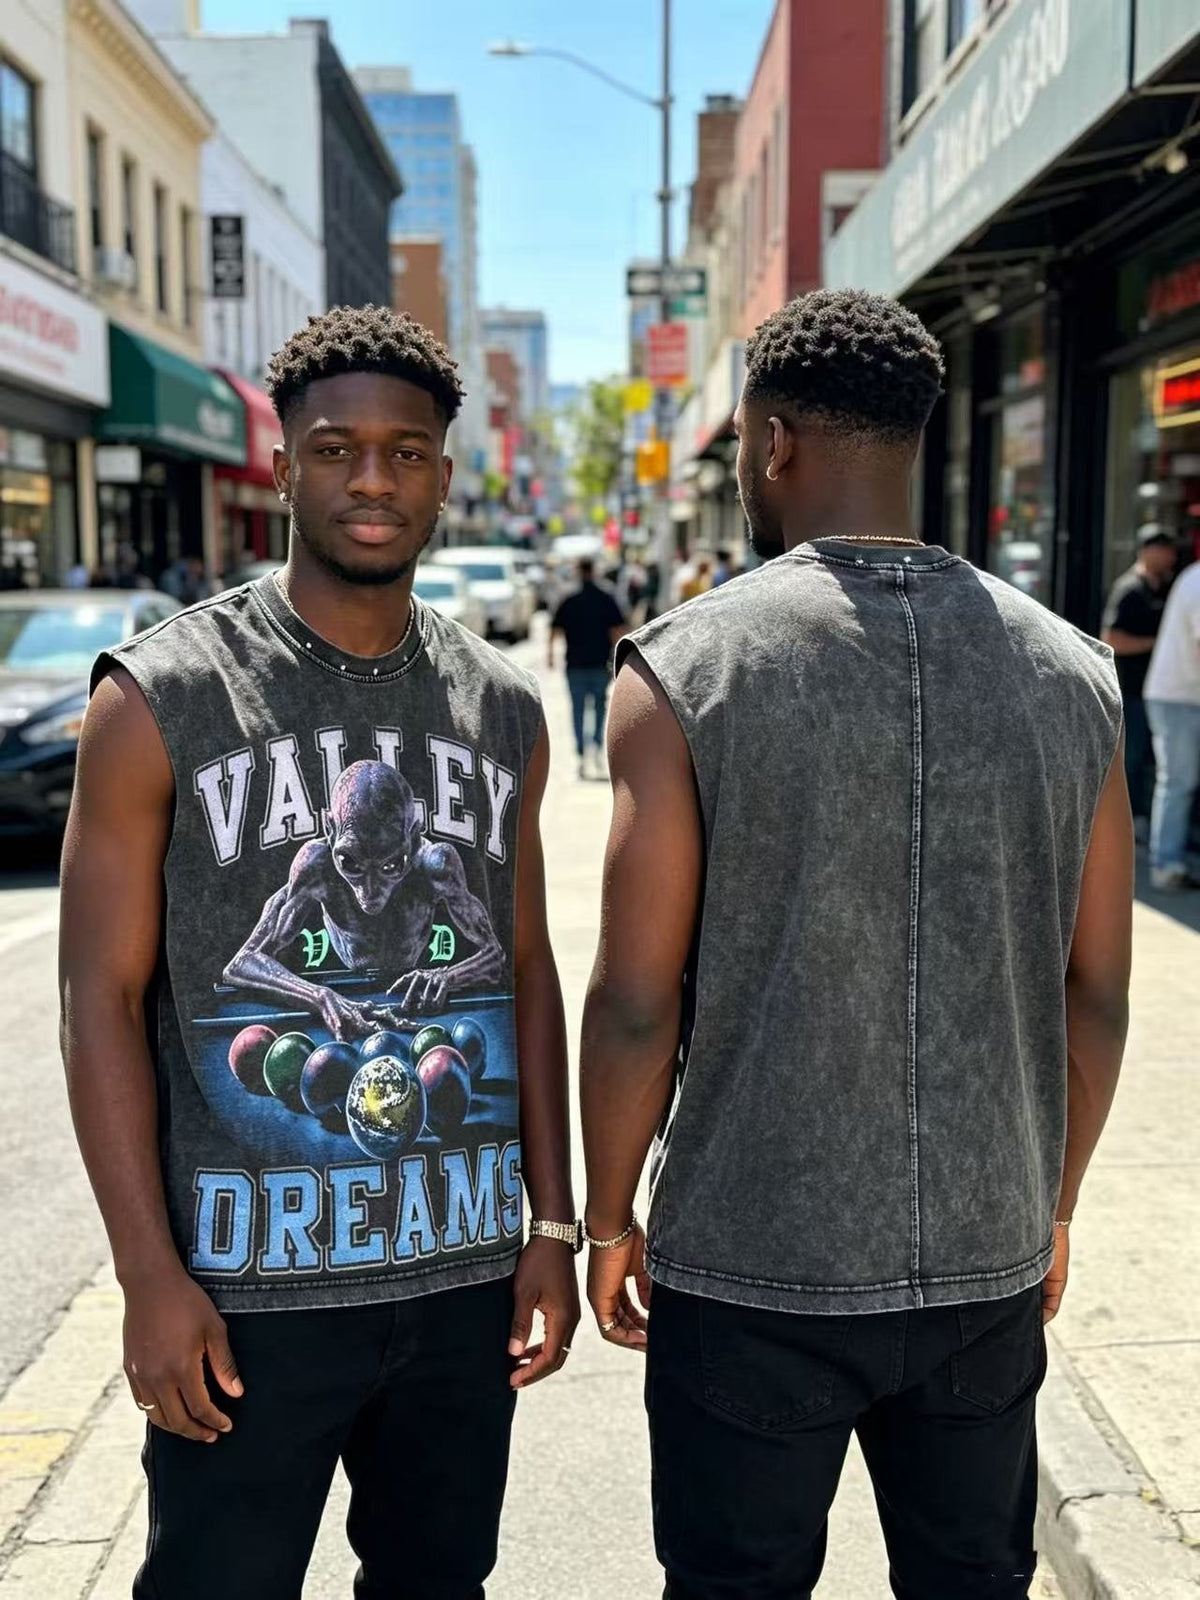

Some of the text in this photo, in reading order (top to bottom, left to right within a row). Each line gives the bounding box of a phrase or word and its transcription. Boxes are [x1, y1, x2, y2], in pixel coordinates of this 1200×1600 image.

[300, 924, 455, 968] V D
[189, 1140, 522, 1276] DREAMS
